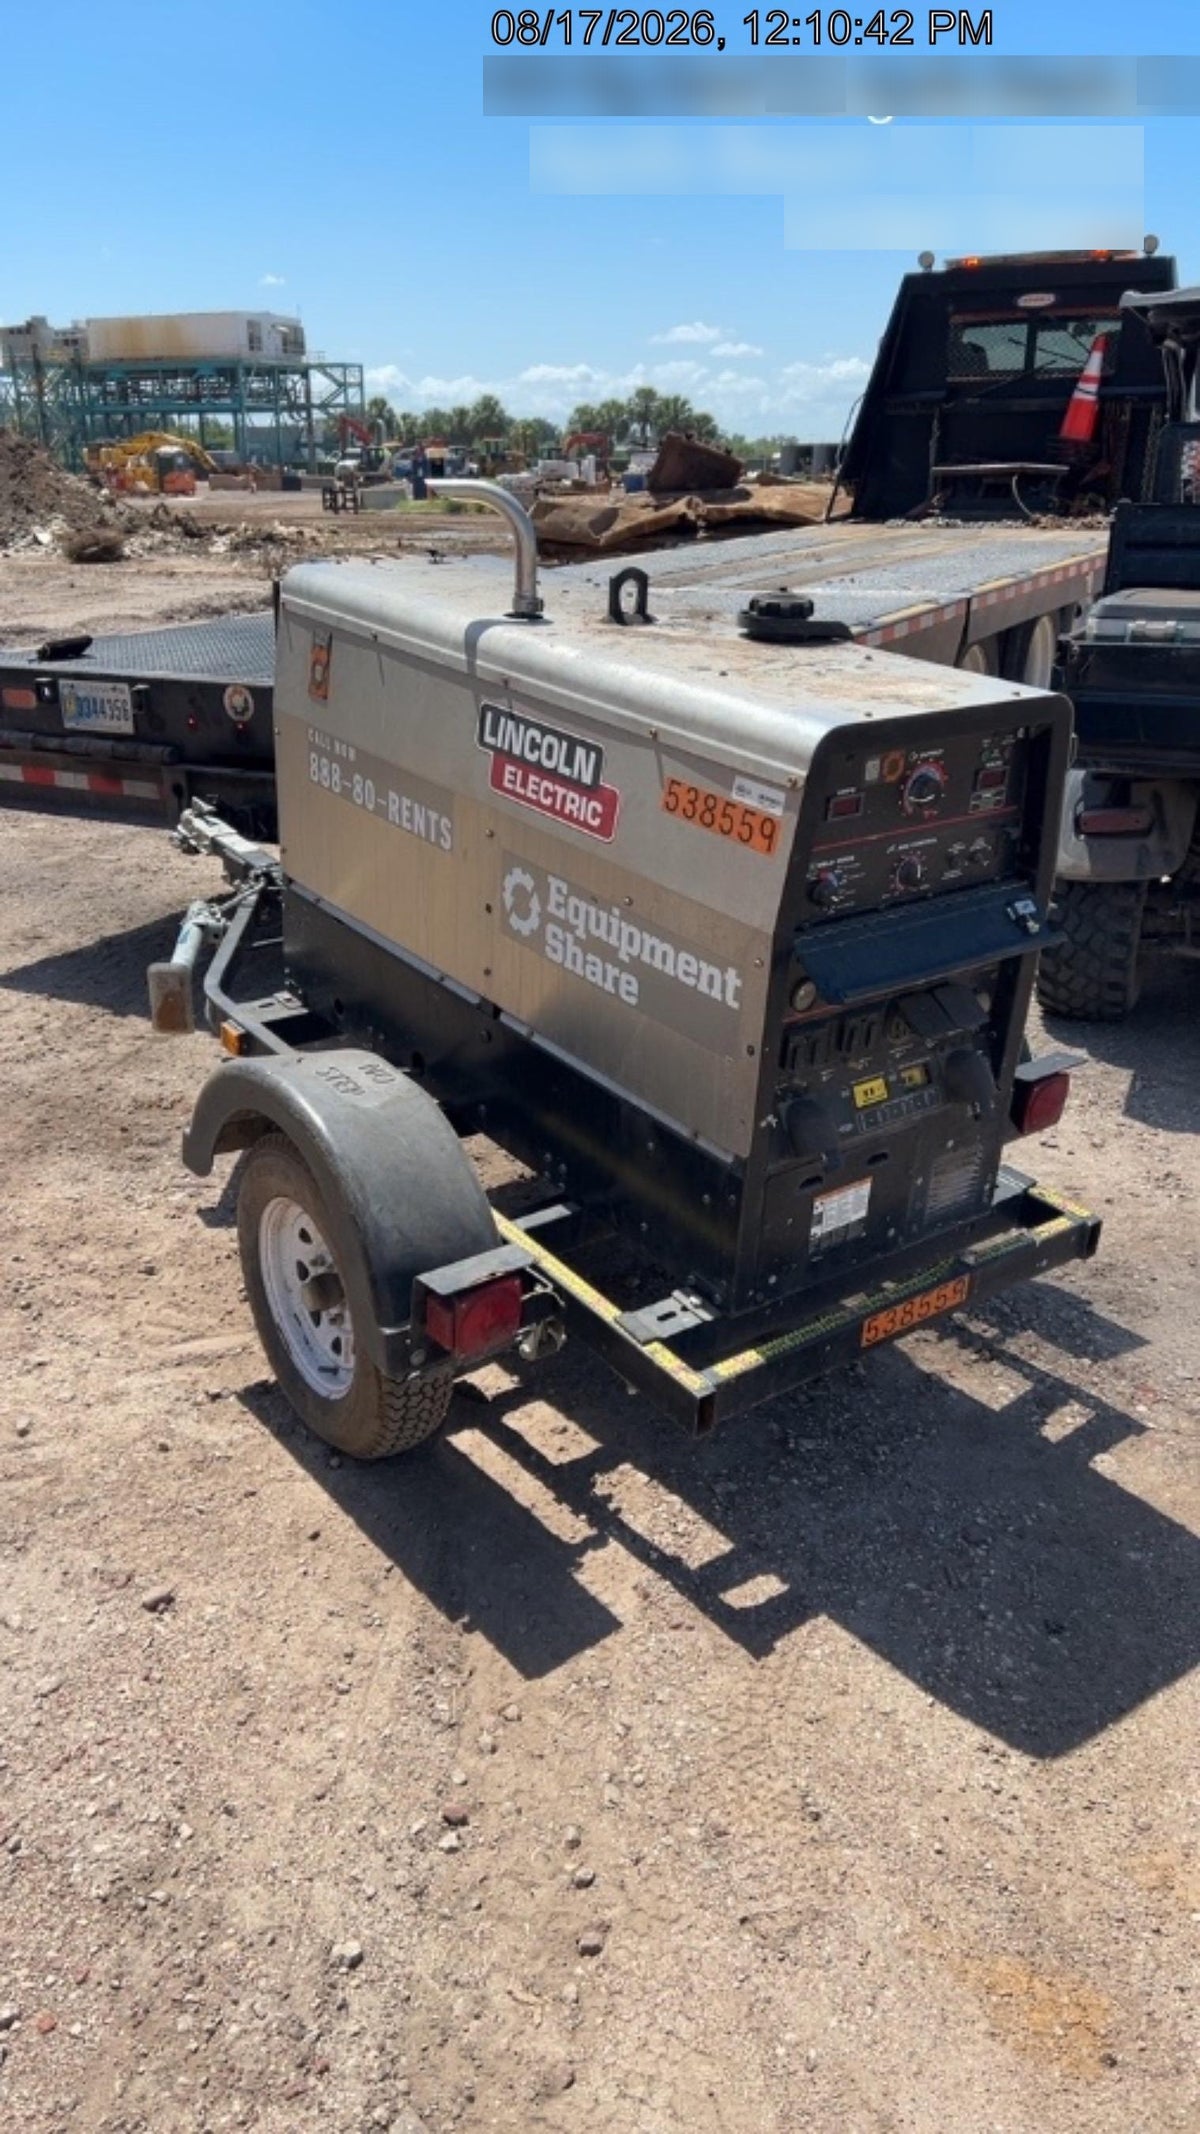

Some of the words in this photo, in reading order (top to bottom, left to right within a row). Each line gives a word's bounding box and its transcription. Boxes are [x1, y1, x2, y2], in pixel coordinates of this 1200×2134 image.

[483, 710, 597, 786] LINCOLN
[309, 751, 452, 850] 888-80-RENTS
[502, 764, 603, 827] ELECTRIC
[664, 779, 776, 852] 538559
[544, 921, 640, 1006] Share
[547, 874, 743, 1010] Equipment
